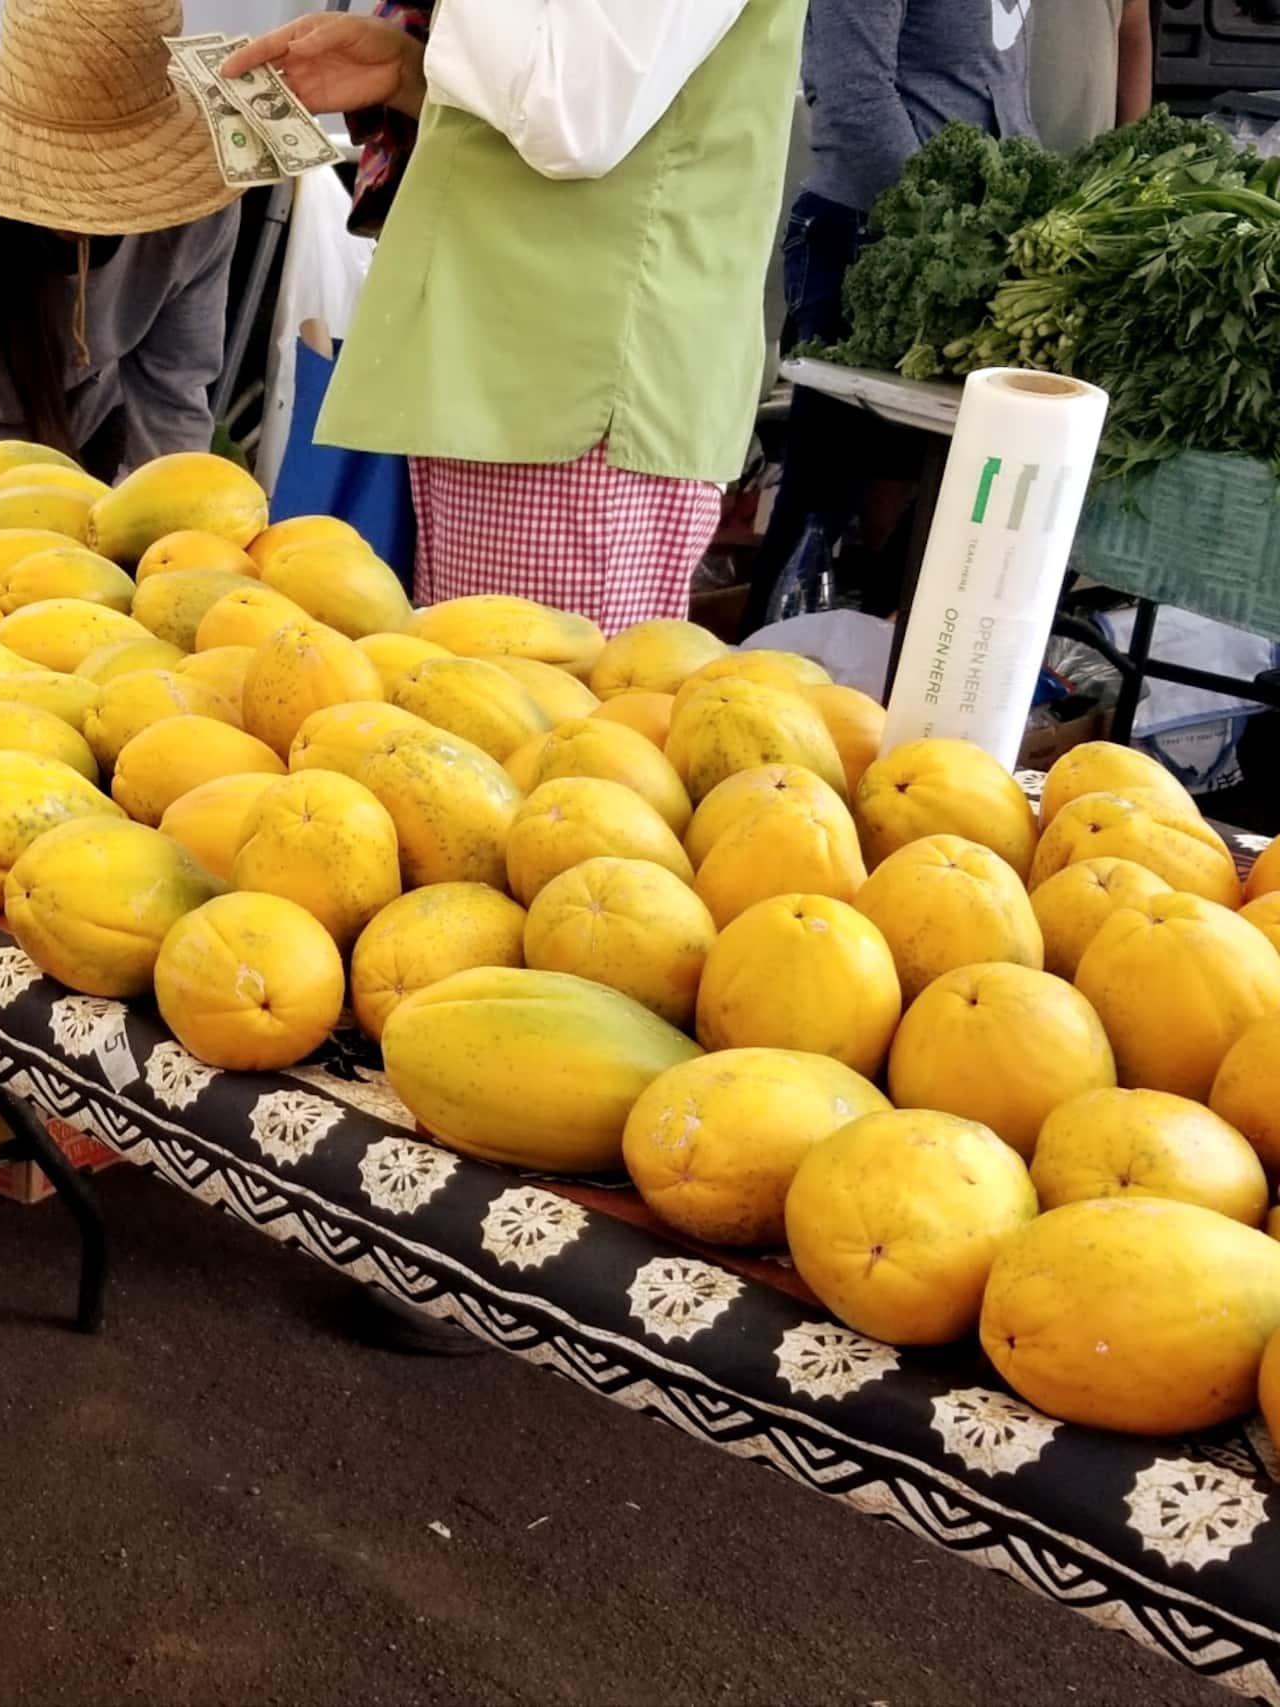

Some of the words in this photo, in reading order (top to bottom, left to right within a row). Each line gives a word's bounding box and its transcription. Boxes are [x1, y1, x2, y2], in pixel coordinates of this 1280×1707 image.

[936, 608, 959, 656] OPEN
[971, 617, 995, 665] OPEN
[924, 657, 947, 705] HERE
[959, 667, 982, 713] HERE
